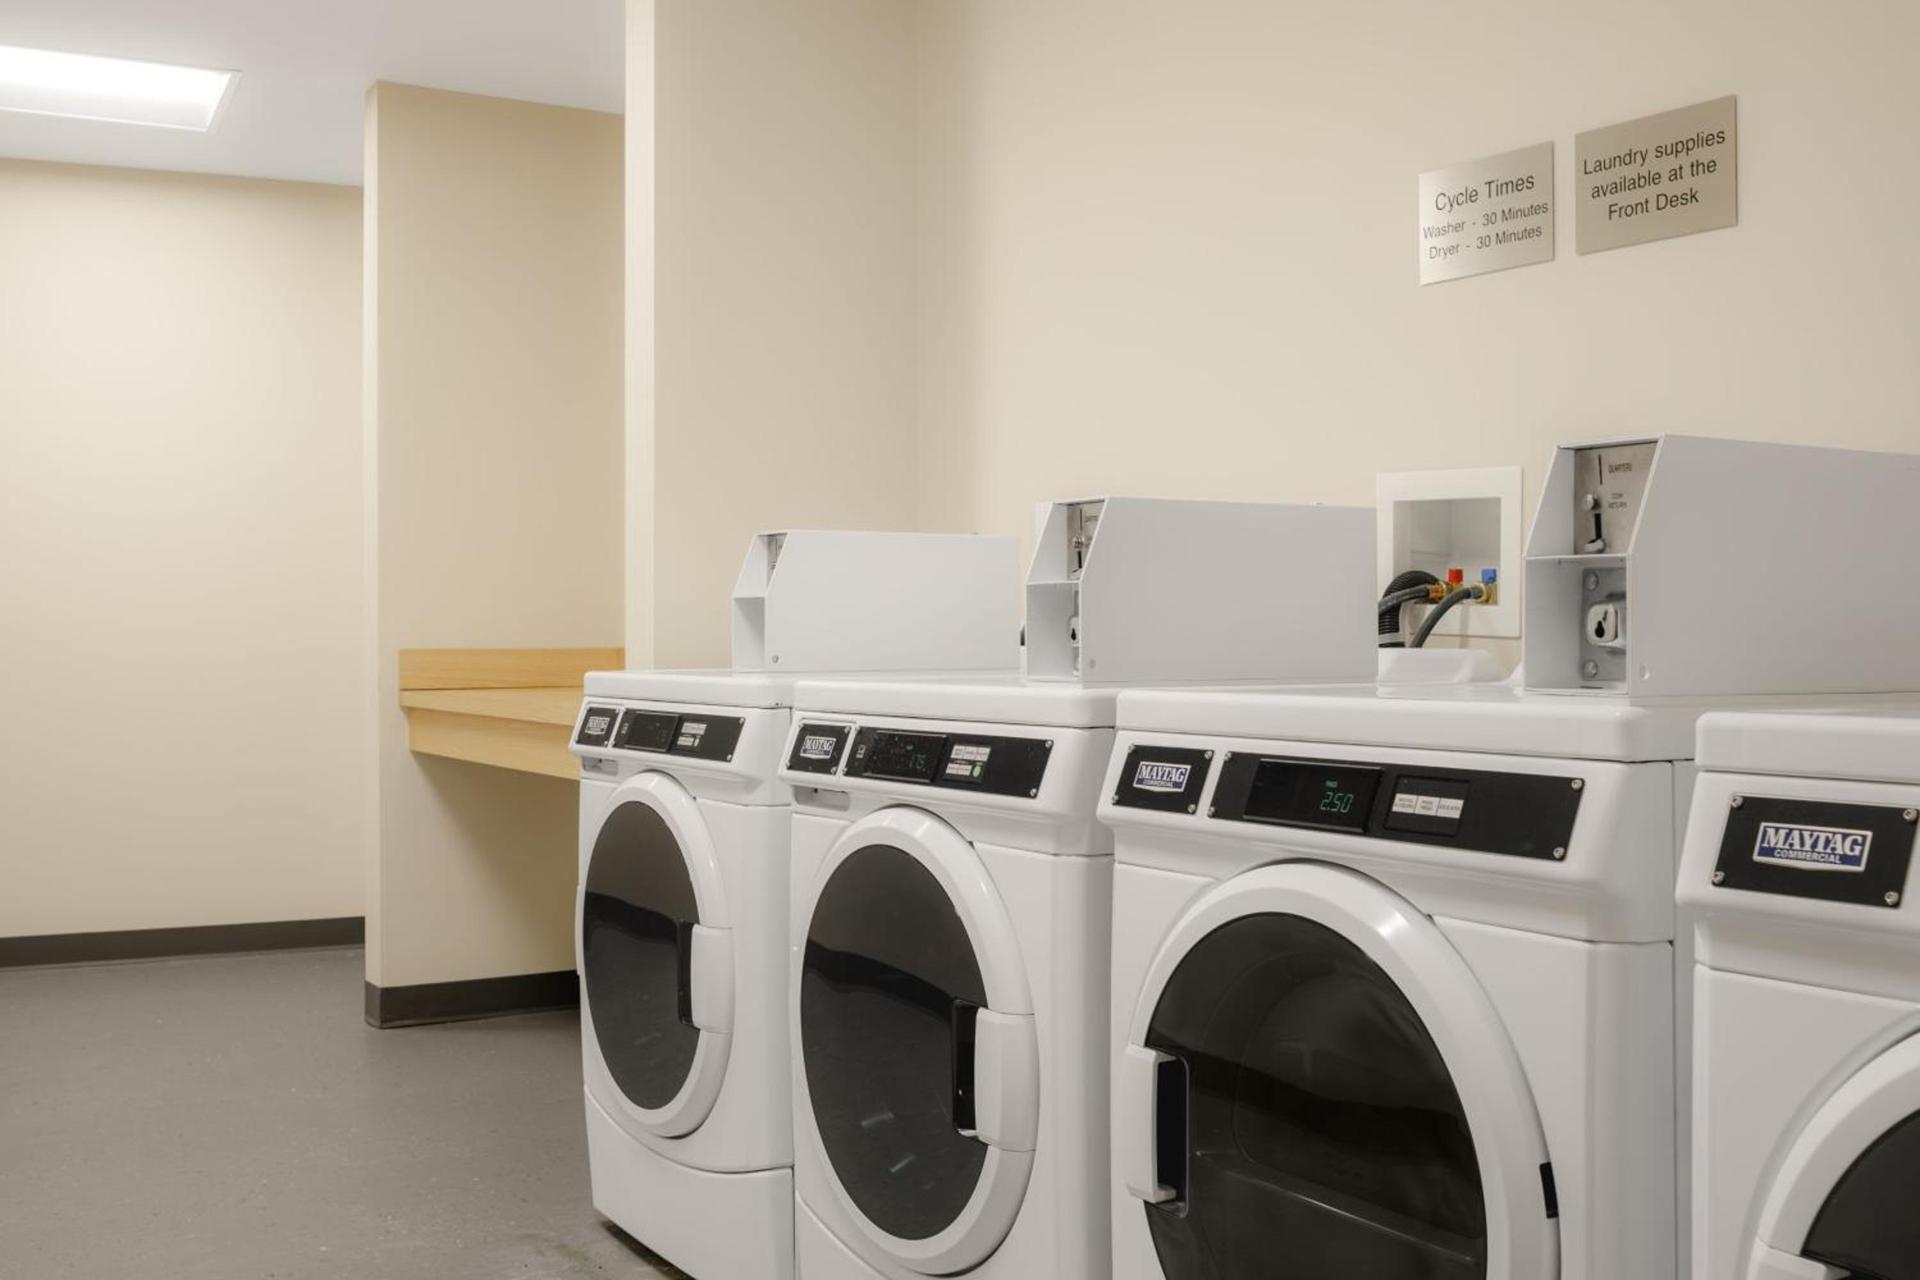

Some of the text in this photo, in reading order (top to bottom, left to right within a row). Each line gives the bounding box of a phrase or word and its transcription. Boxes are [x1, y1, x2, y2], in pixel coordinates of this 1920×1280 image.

[1583, 130, 1726, 175] Laundry supplies
[1435, 174, 1535, 212] Cycle Times
[1591, 157, 1717, 199] available at the
[1608, 188, 1699, 220] Front Desk
[1422, 221, 1466, 241] Washer
[1482, 211, 1497, 227] 30
[1501, 202, 1549, 222] Minutes
[1429, 243, 1460, 260] Dryer
[1476, 235, 1491, 250] 30
[1495, 225, 1542, 246] Minutes
[1139, 765, 1186, 782] MAYTAG
[1320, 791, 1354, 813] 2.50
[1761, 827, 1863, 857] MAYTAG
[1773, 849, 1842, 864] COMMERCIAL
